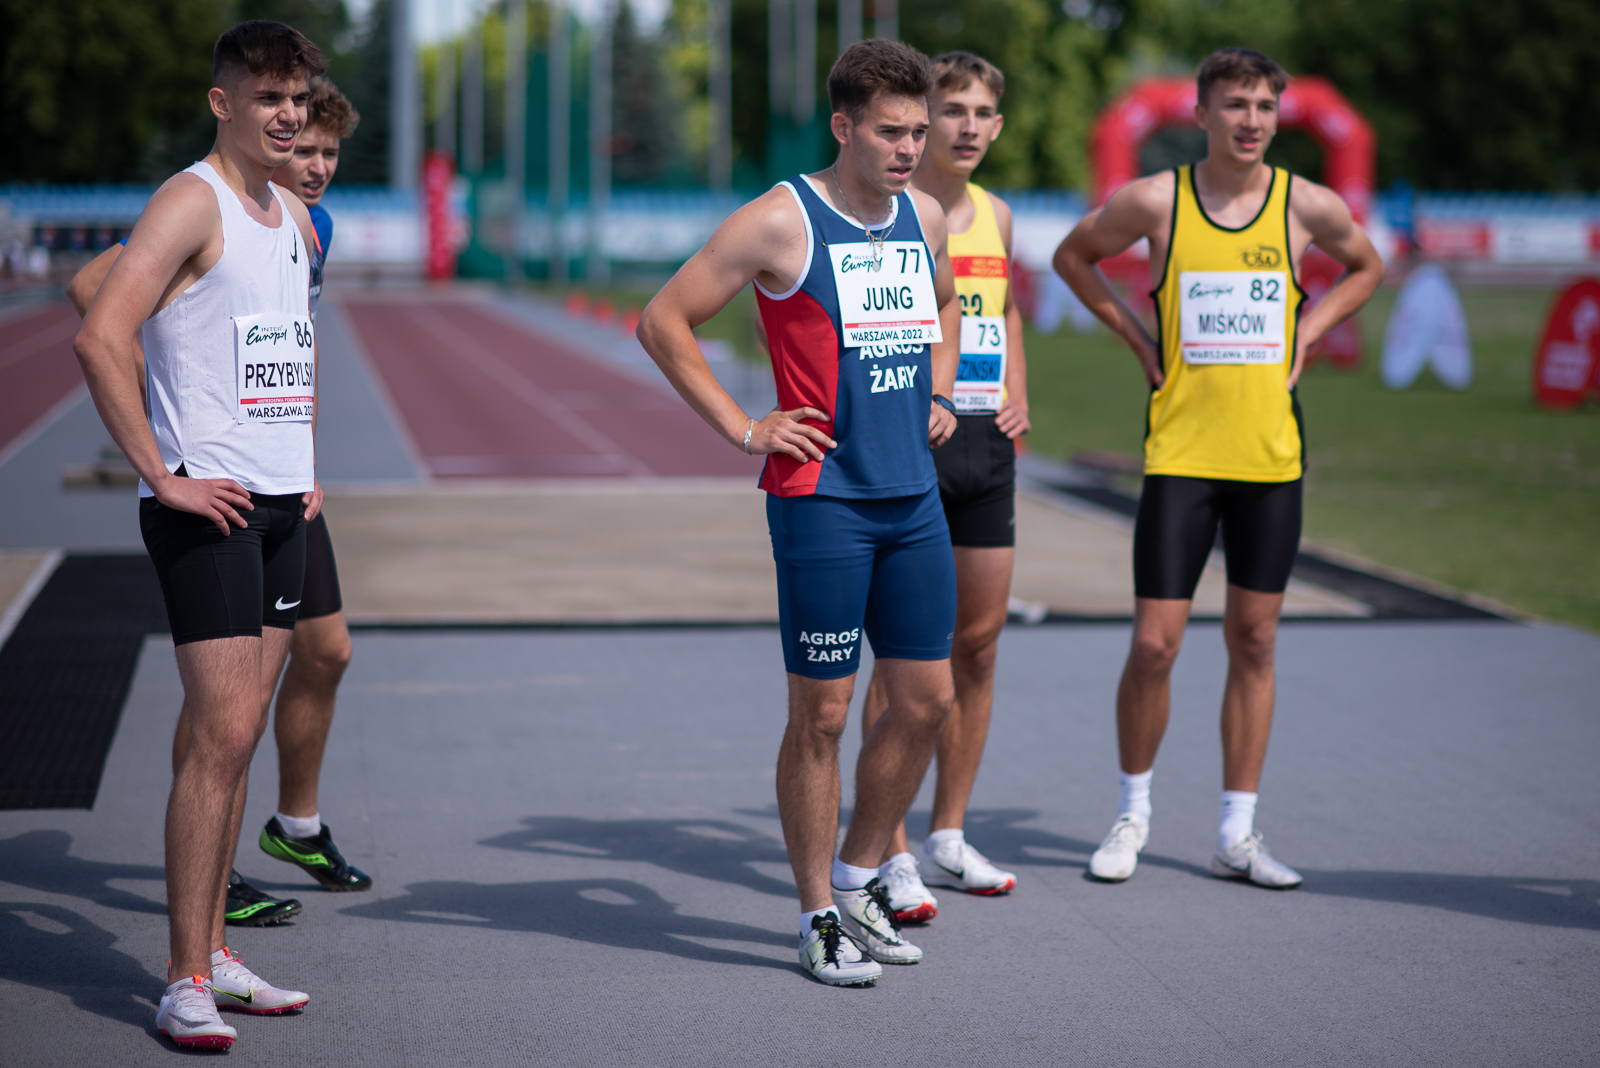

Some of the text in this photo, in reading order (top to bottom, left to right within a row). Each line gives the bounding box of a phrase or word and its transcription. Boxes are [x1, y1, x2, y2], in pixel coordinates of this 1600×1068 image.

[841, 253, 883, 273] Europl
[896, 248, 920, 274] 77
[862, 286, 914, 311] JUNG
[1250, 278, 1280, 301] 82
[1198, 307, 1267, 334] MIŚKÓW
[245, 324, 288, 346] Europol
[294, 320, 313, 348] 86
[850, 328, 923, 342] WARSZAWA 2022
[978, 323, 1001, 347] 73
[1189, 350, 1267, 359] WARSZAWA 2022
[245, 361, 314, 388] PRZYBYLSK
[869, 363, 918, 394] ŻARY
[956, 355, 999, 380] ZIŃSKI
[246, 405, 303, 418] WARSZAWA
[968, 396, 987, 405] 2022
[799, 628, 859, 645] AGROS
[806, 646, 854, 663] ŻARY
